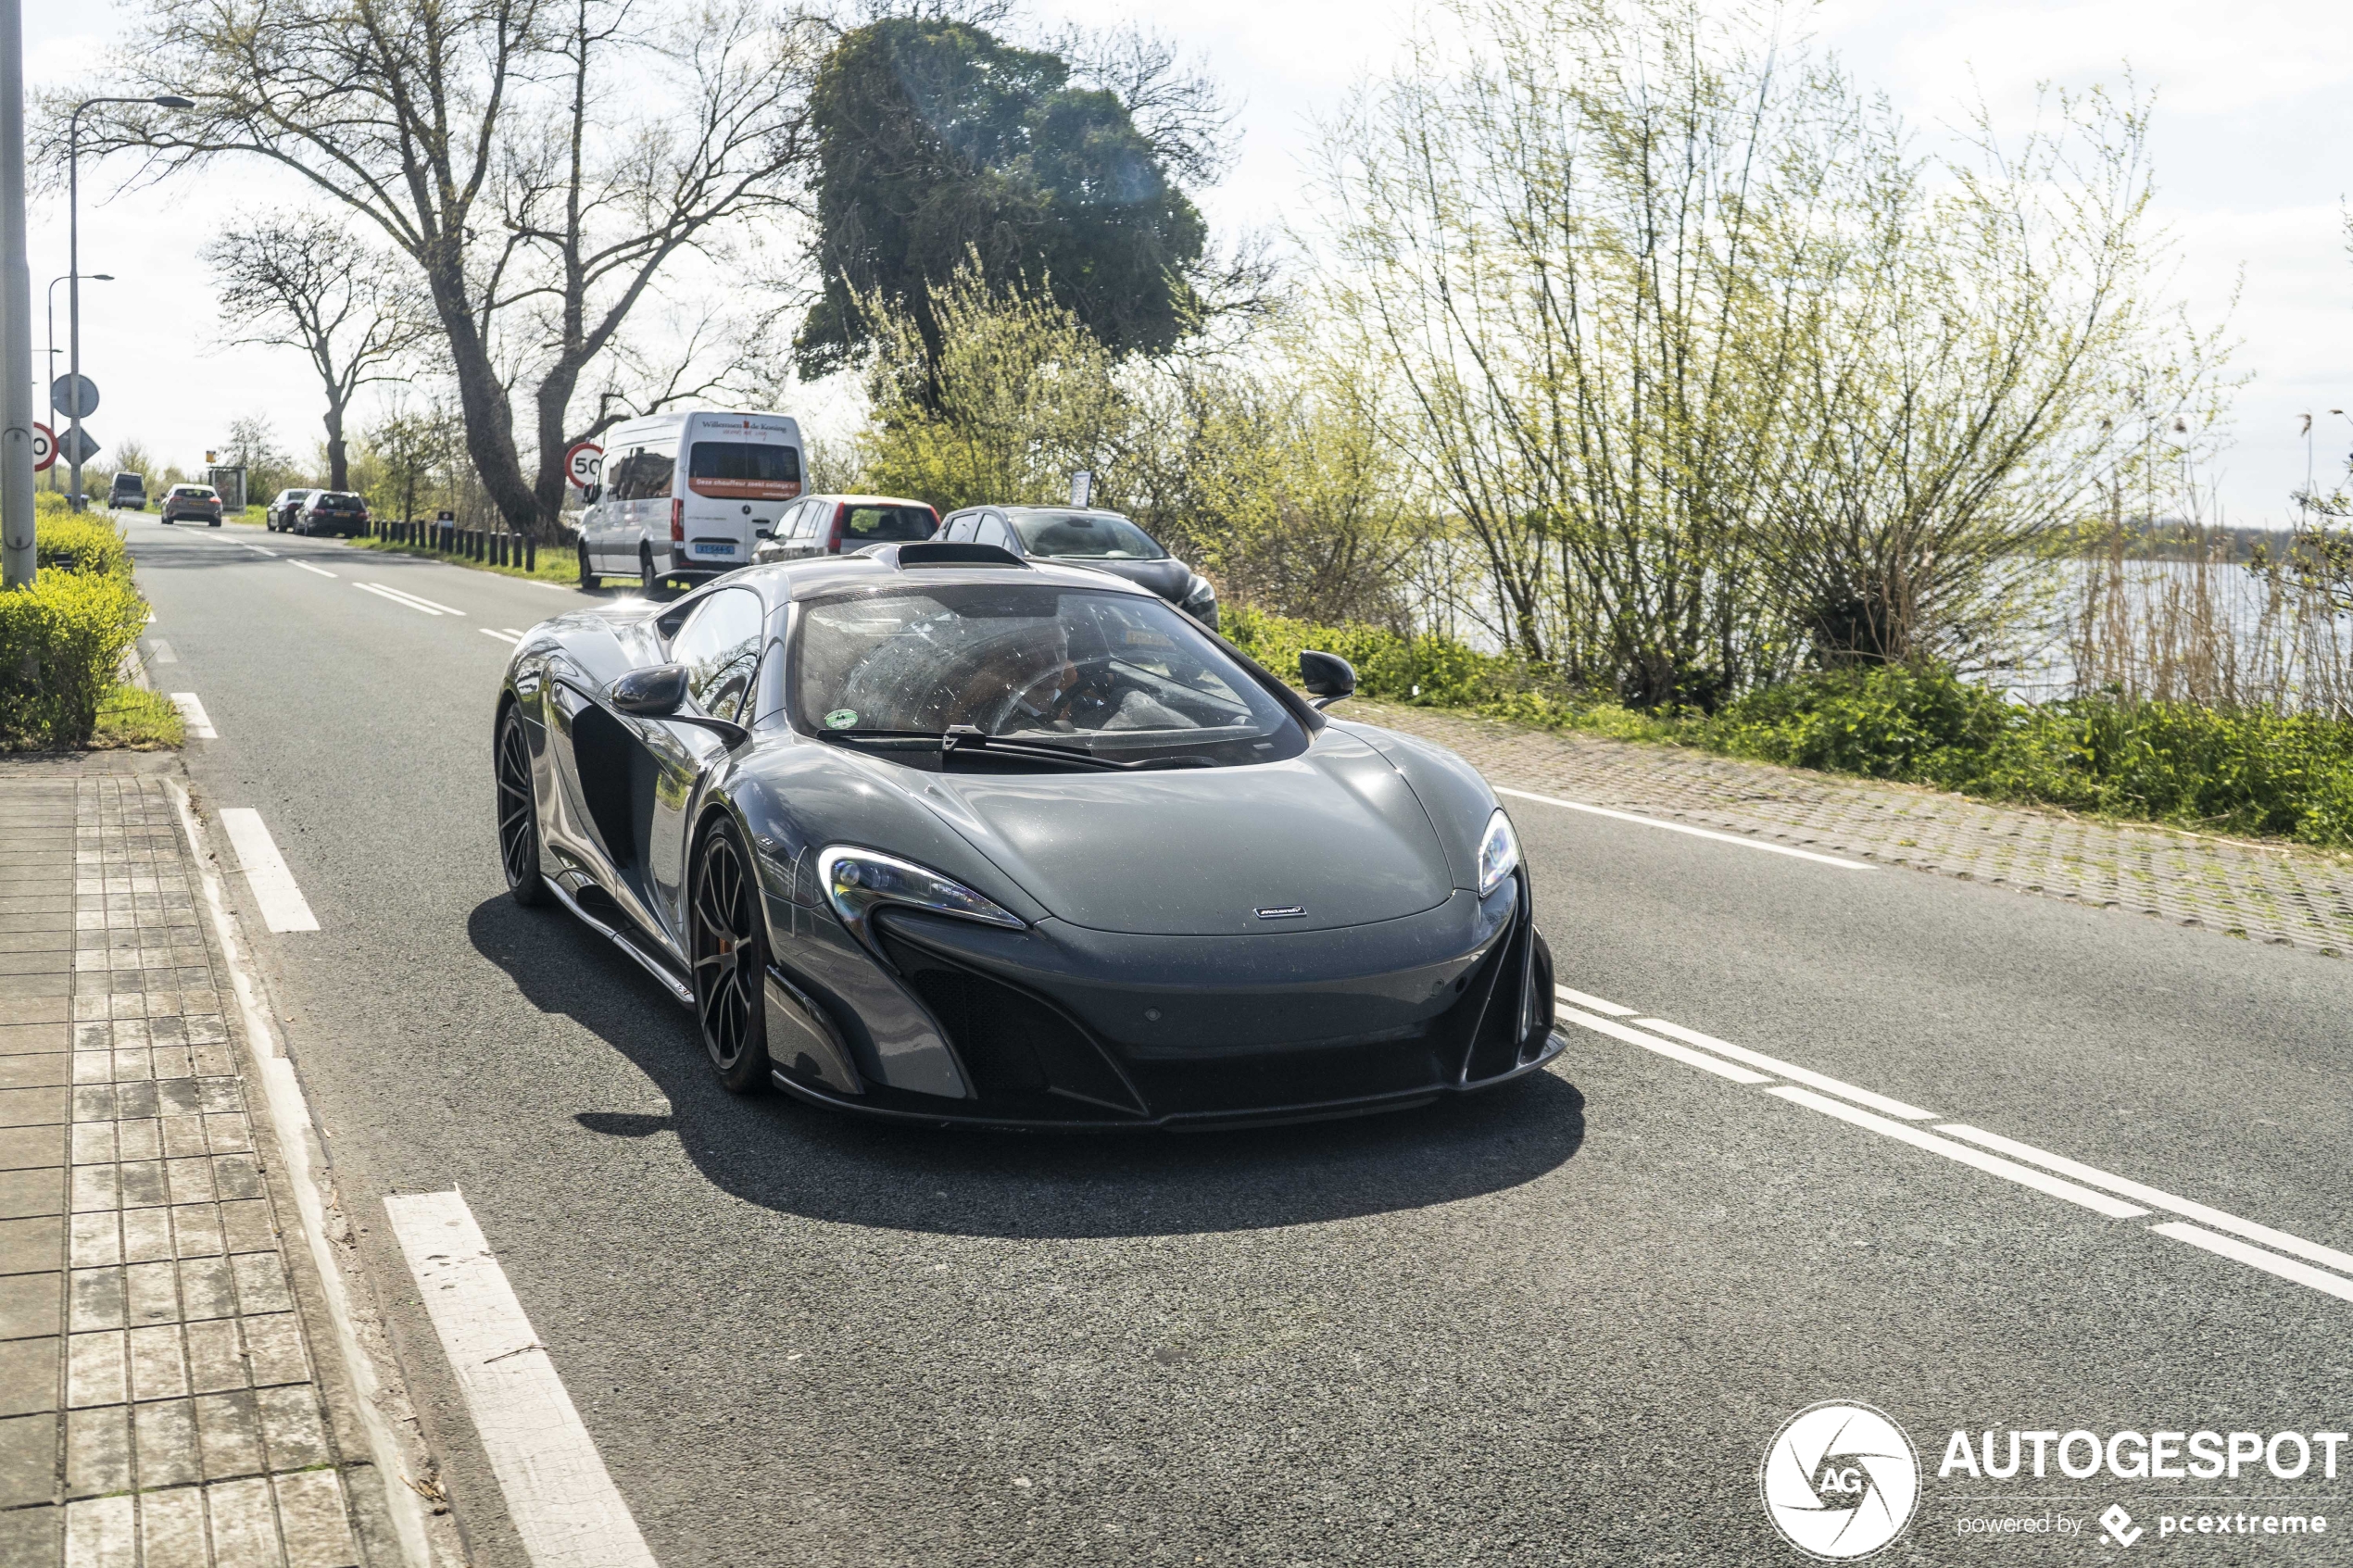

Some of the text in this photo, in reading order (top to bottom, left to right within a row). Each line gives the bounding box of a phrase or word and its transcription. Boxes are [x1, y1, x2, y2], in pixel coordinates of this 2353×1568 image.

[702, 420, 742, 429] Willemsen
[761, 423, 787, 433] Koning
[574, 458, 600, 475] 50
[696, 478, 712, 486] Deze
[713, 479, 746, 487] chauffeur
